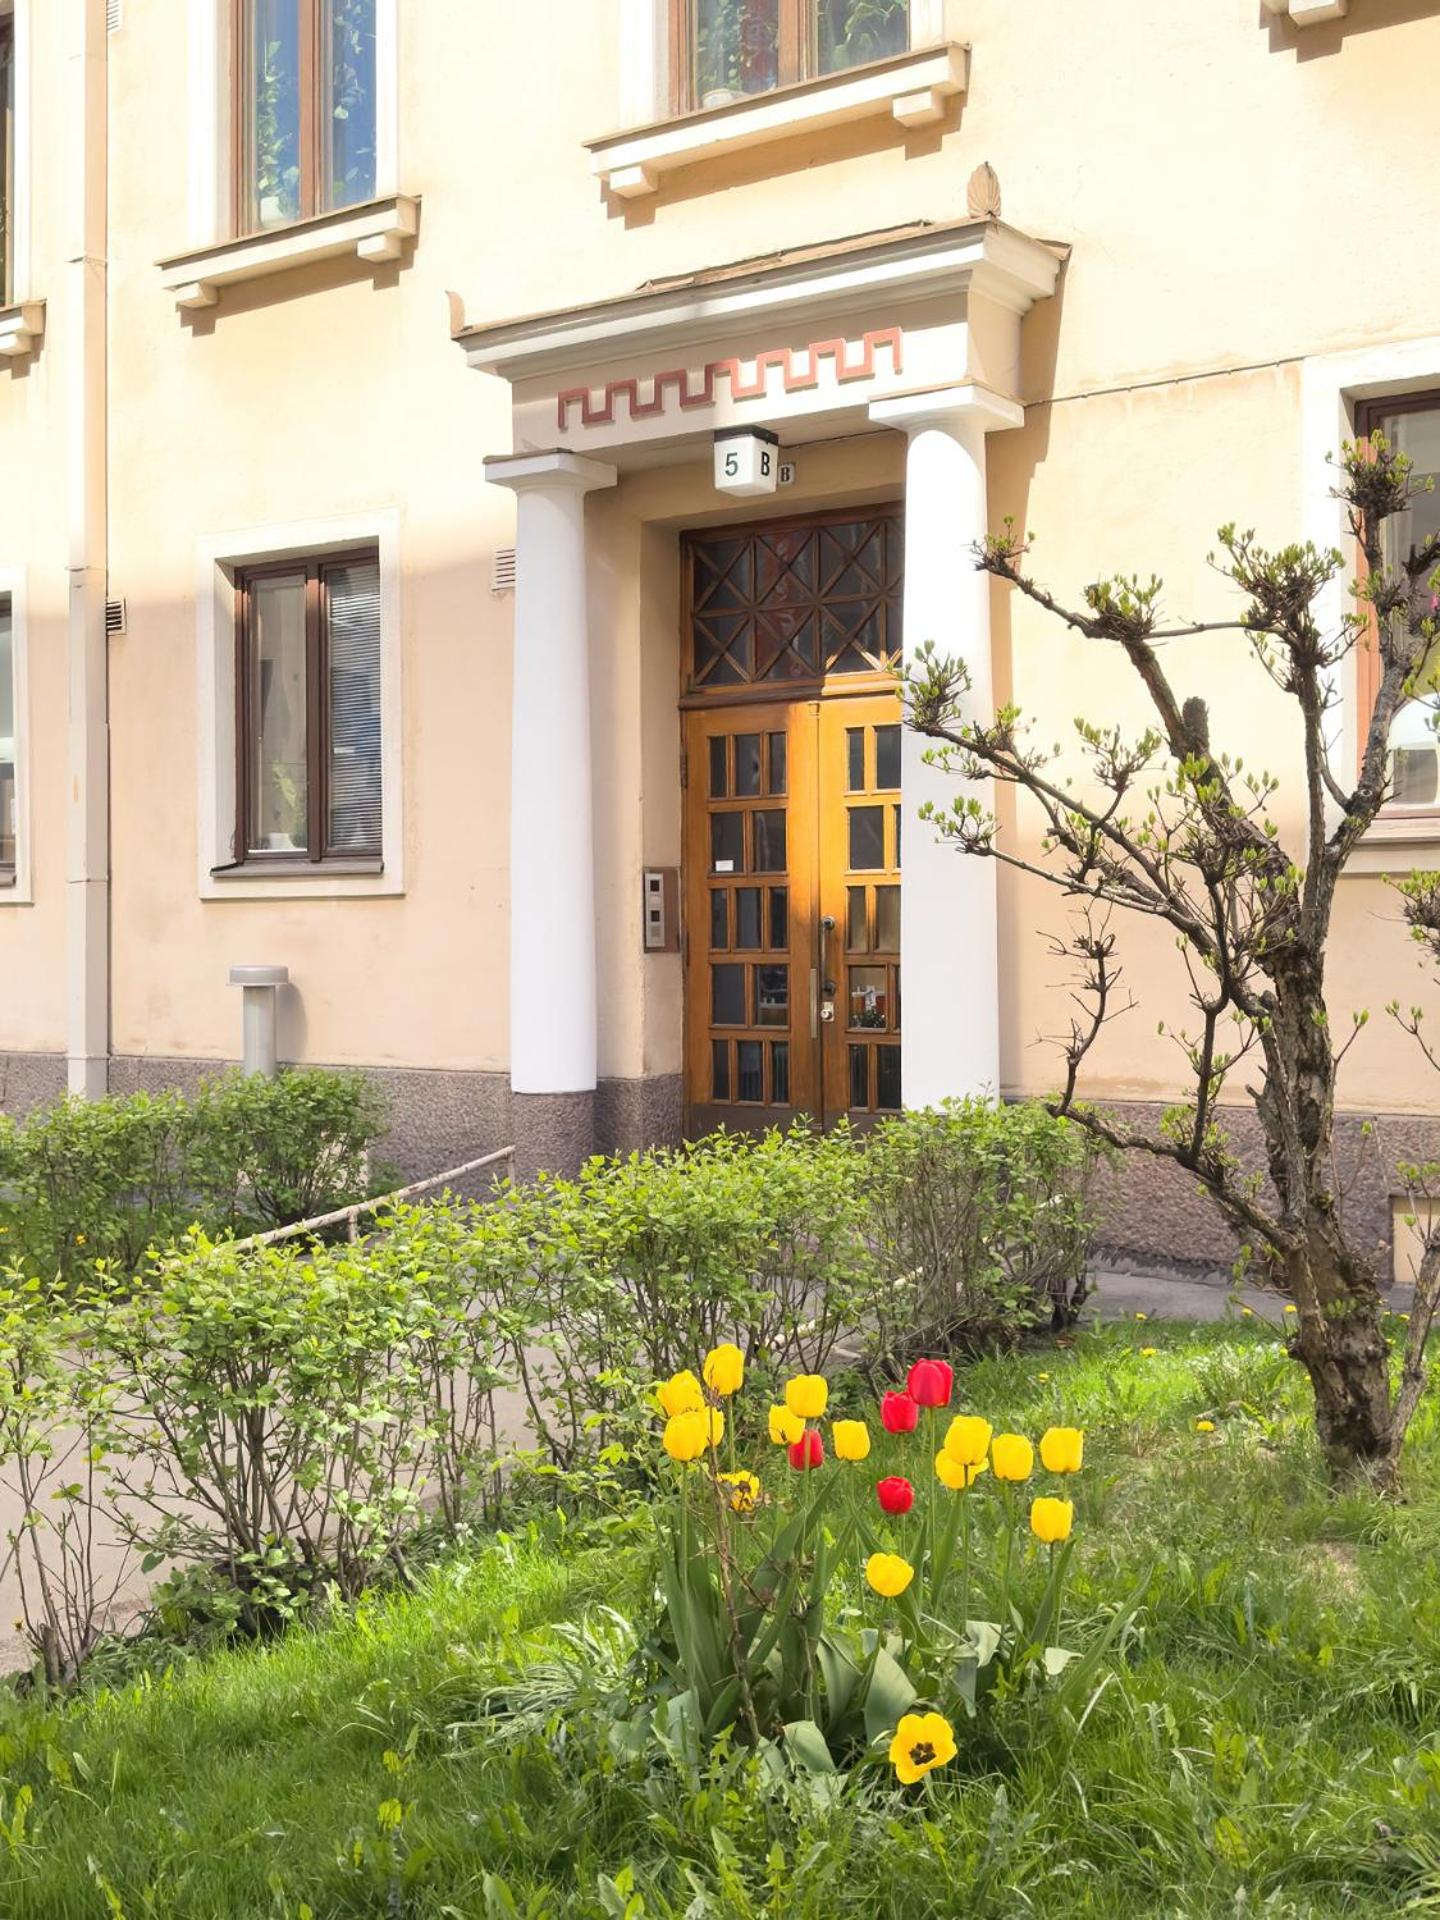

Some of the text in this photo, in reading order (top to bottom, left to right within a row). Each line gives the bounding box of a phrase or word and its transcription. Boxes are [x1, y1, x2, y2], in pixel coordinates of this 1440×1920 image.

[725, 452, 738, 476] 5
[761, 451, 770, 476] B
[781, 467, 790, 482] B
